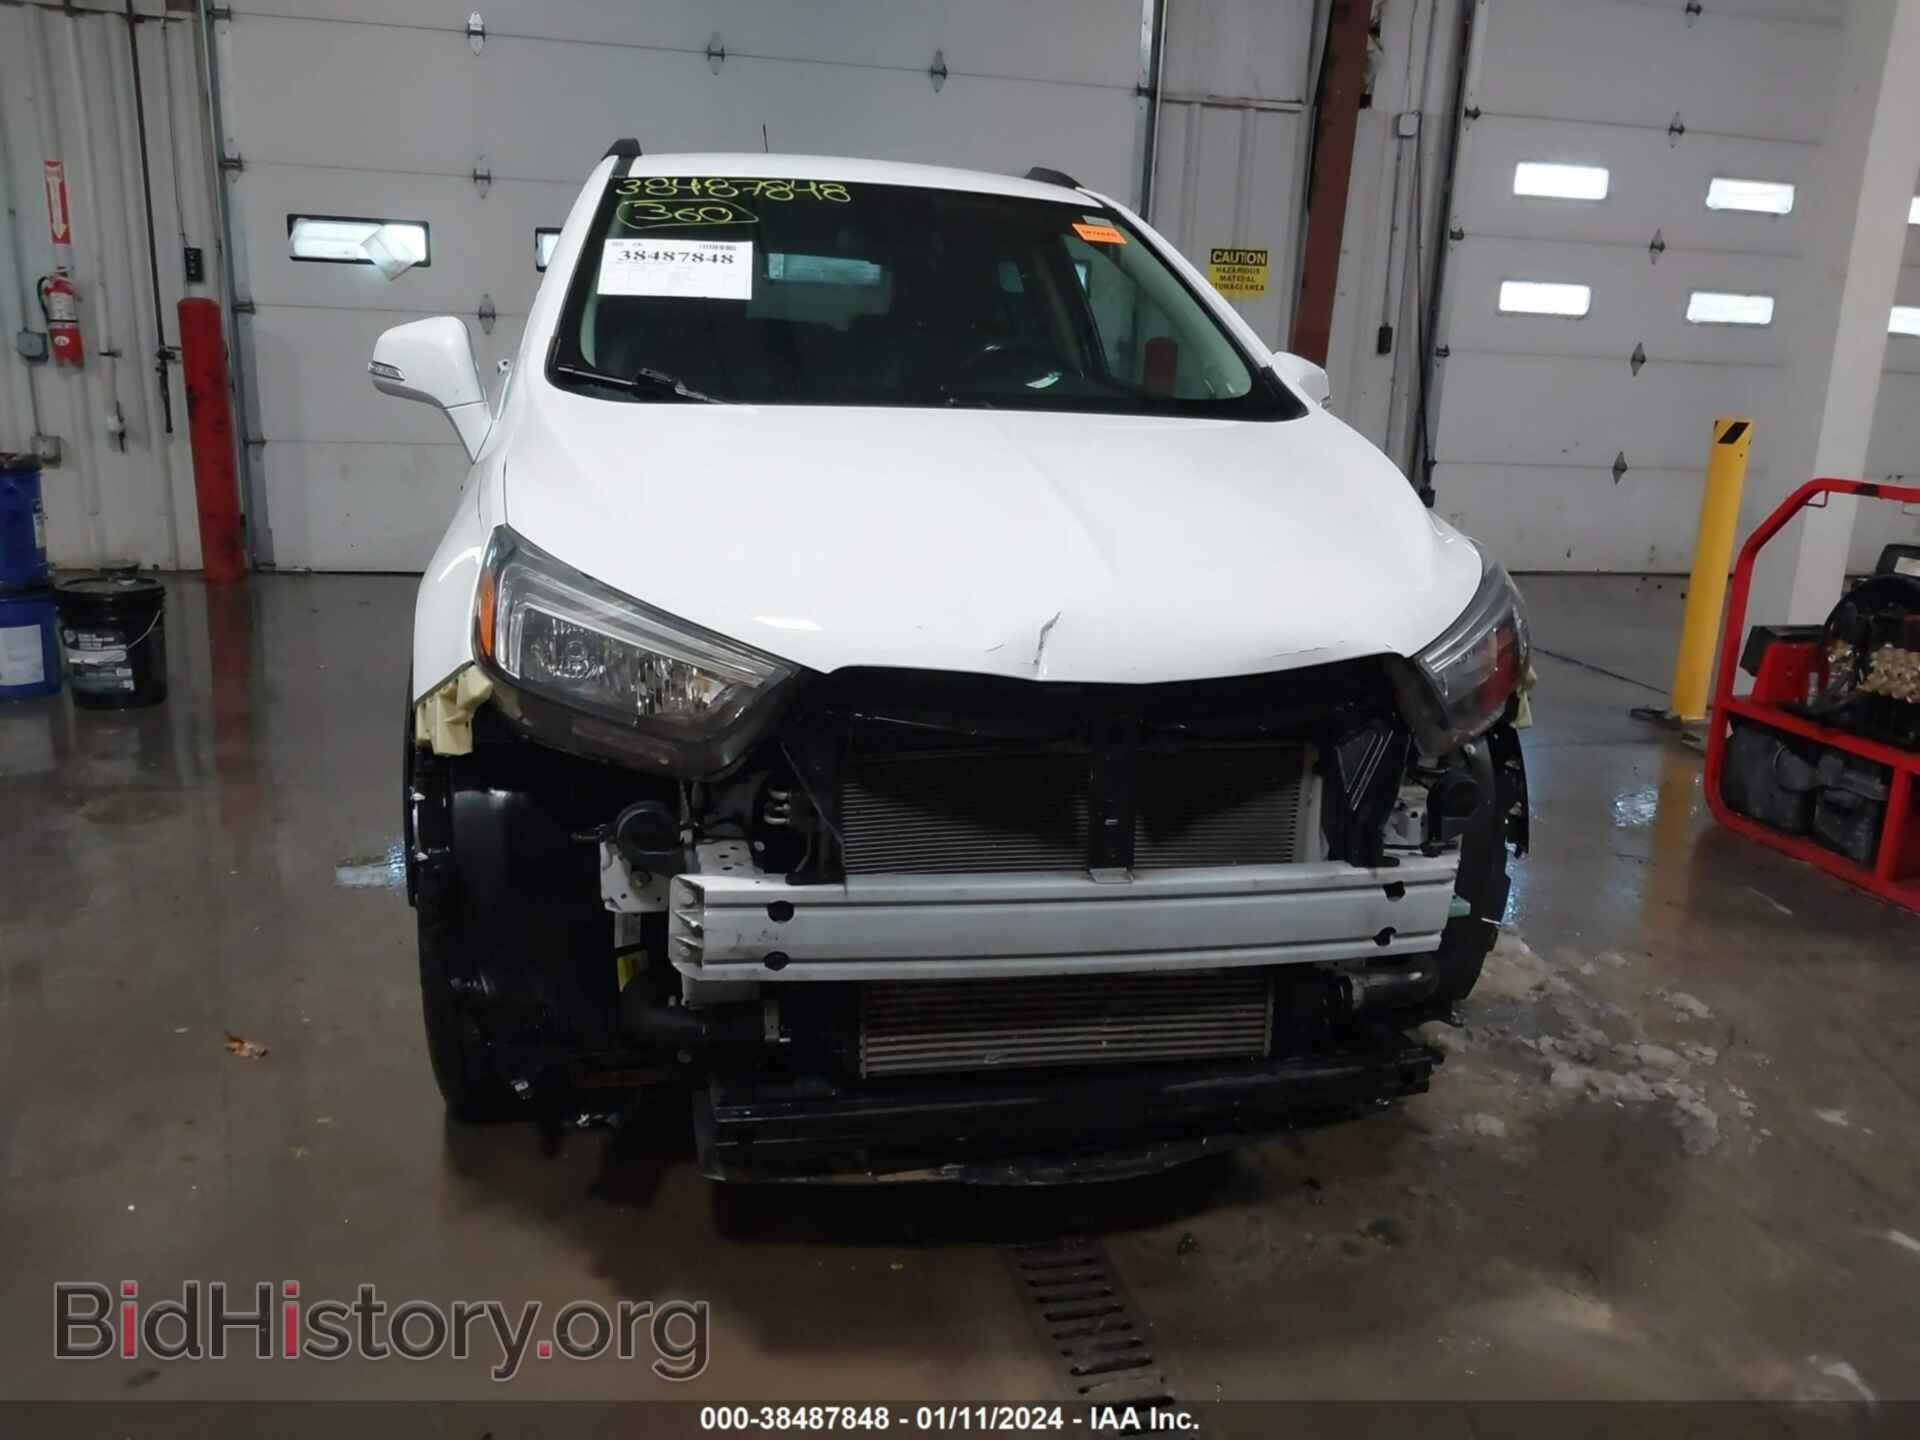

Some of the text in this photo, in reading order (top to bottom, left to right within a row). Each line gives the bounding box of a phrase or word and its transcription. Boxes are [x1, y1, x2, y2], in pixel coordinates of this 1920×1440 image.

[615, 177, 852, 202] 38487848
[632, 203, 734, 224] 360
[617, 249, 735, 265] 38487848
[1212, 250, 1266, 265] CAUTION
